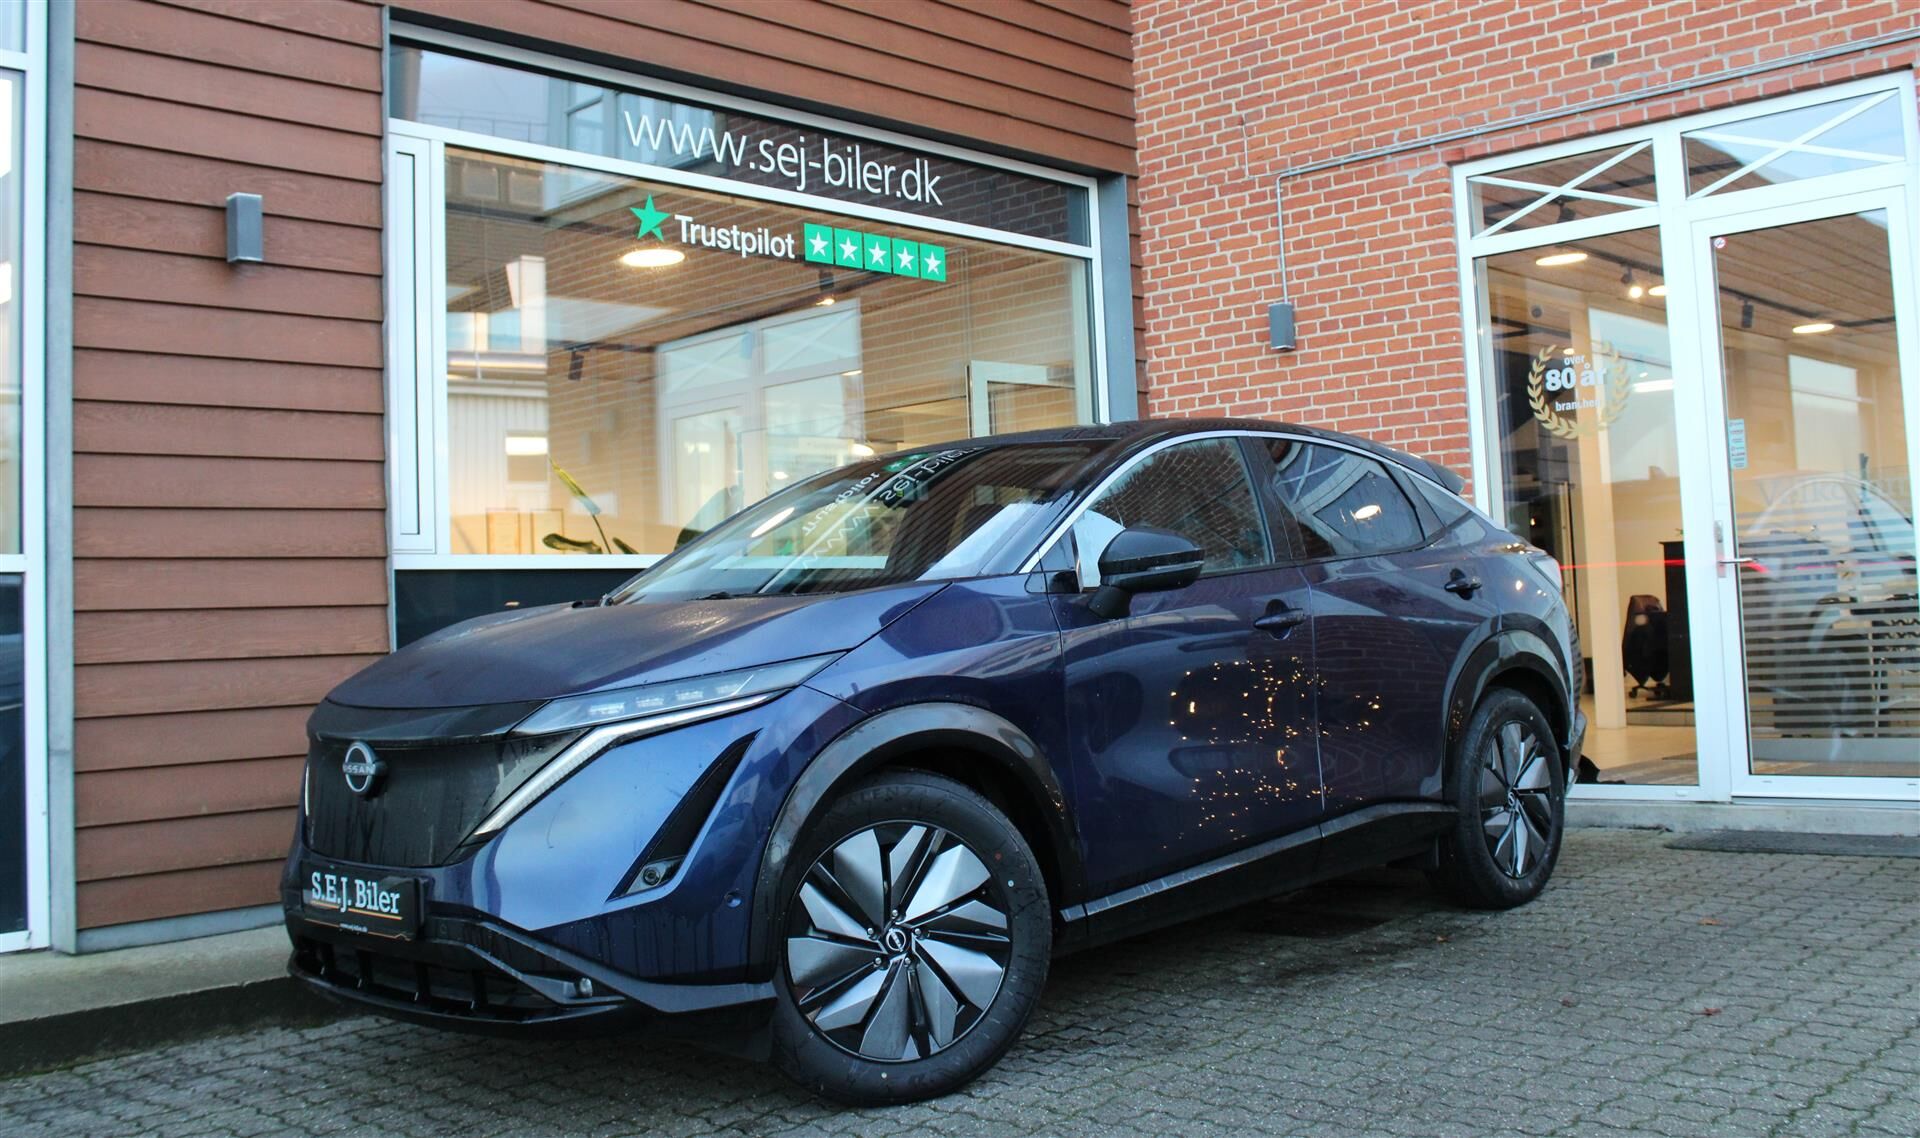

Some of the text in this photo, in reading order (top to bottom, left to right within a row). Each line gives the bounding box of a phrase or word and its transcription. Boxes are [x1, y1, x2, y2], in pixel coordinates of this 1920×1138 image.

[624, 111, 943, 206] www.sej-biler.dk
[674, 214, 795, 259] Trustpilot
[1545, 362, 1607, 391] 80 år
[1563, 354, 1585, 366] over
[342, 763, 376, 775] SSAN
[311, 871, 400, 914] S.E.J. Biler
